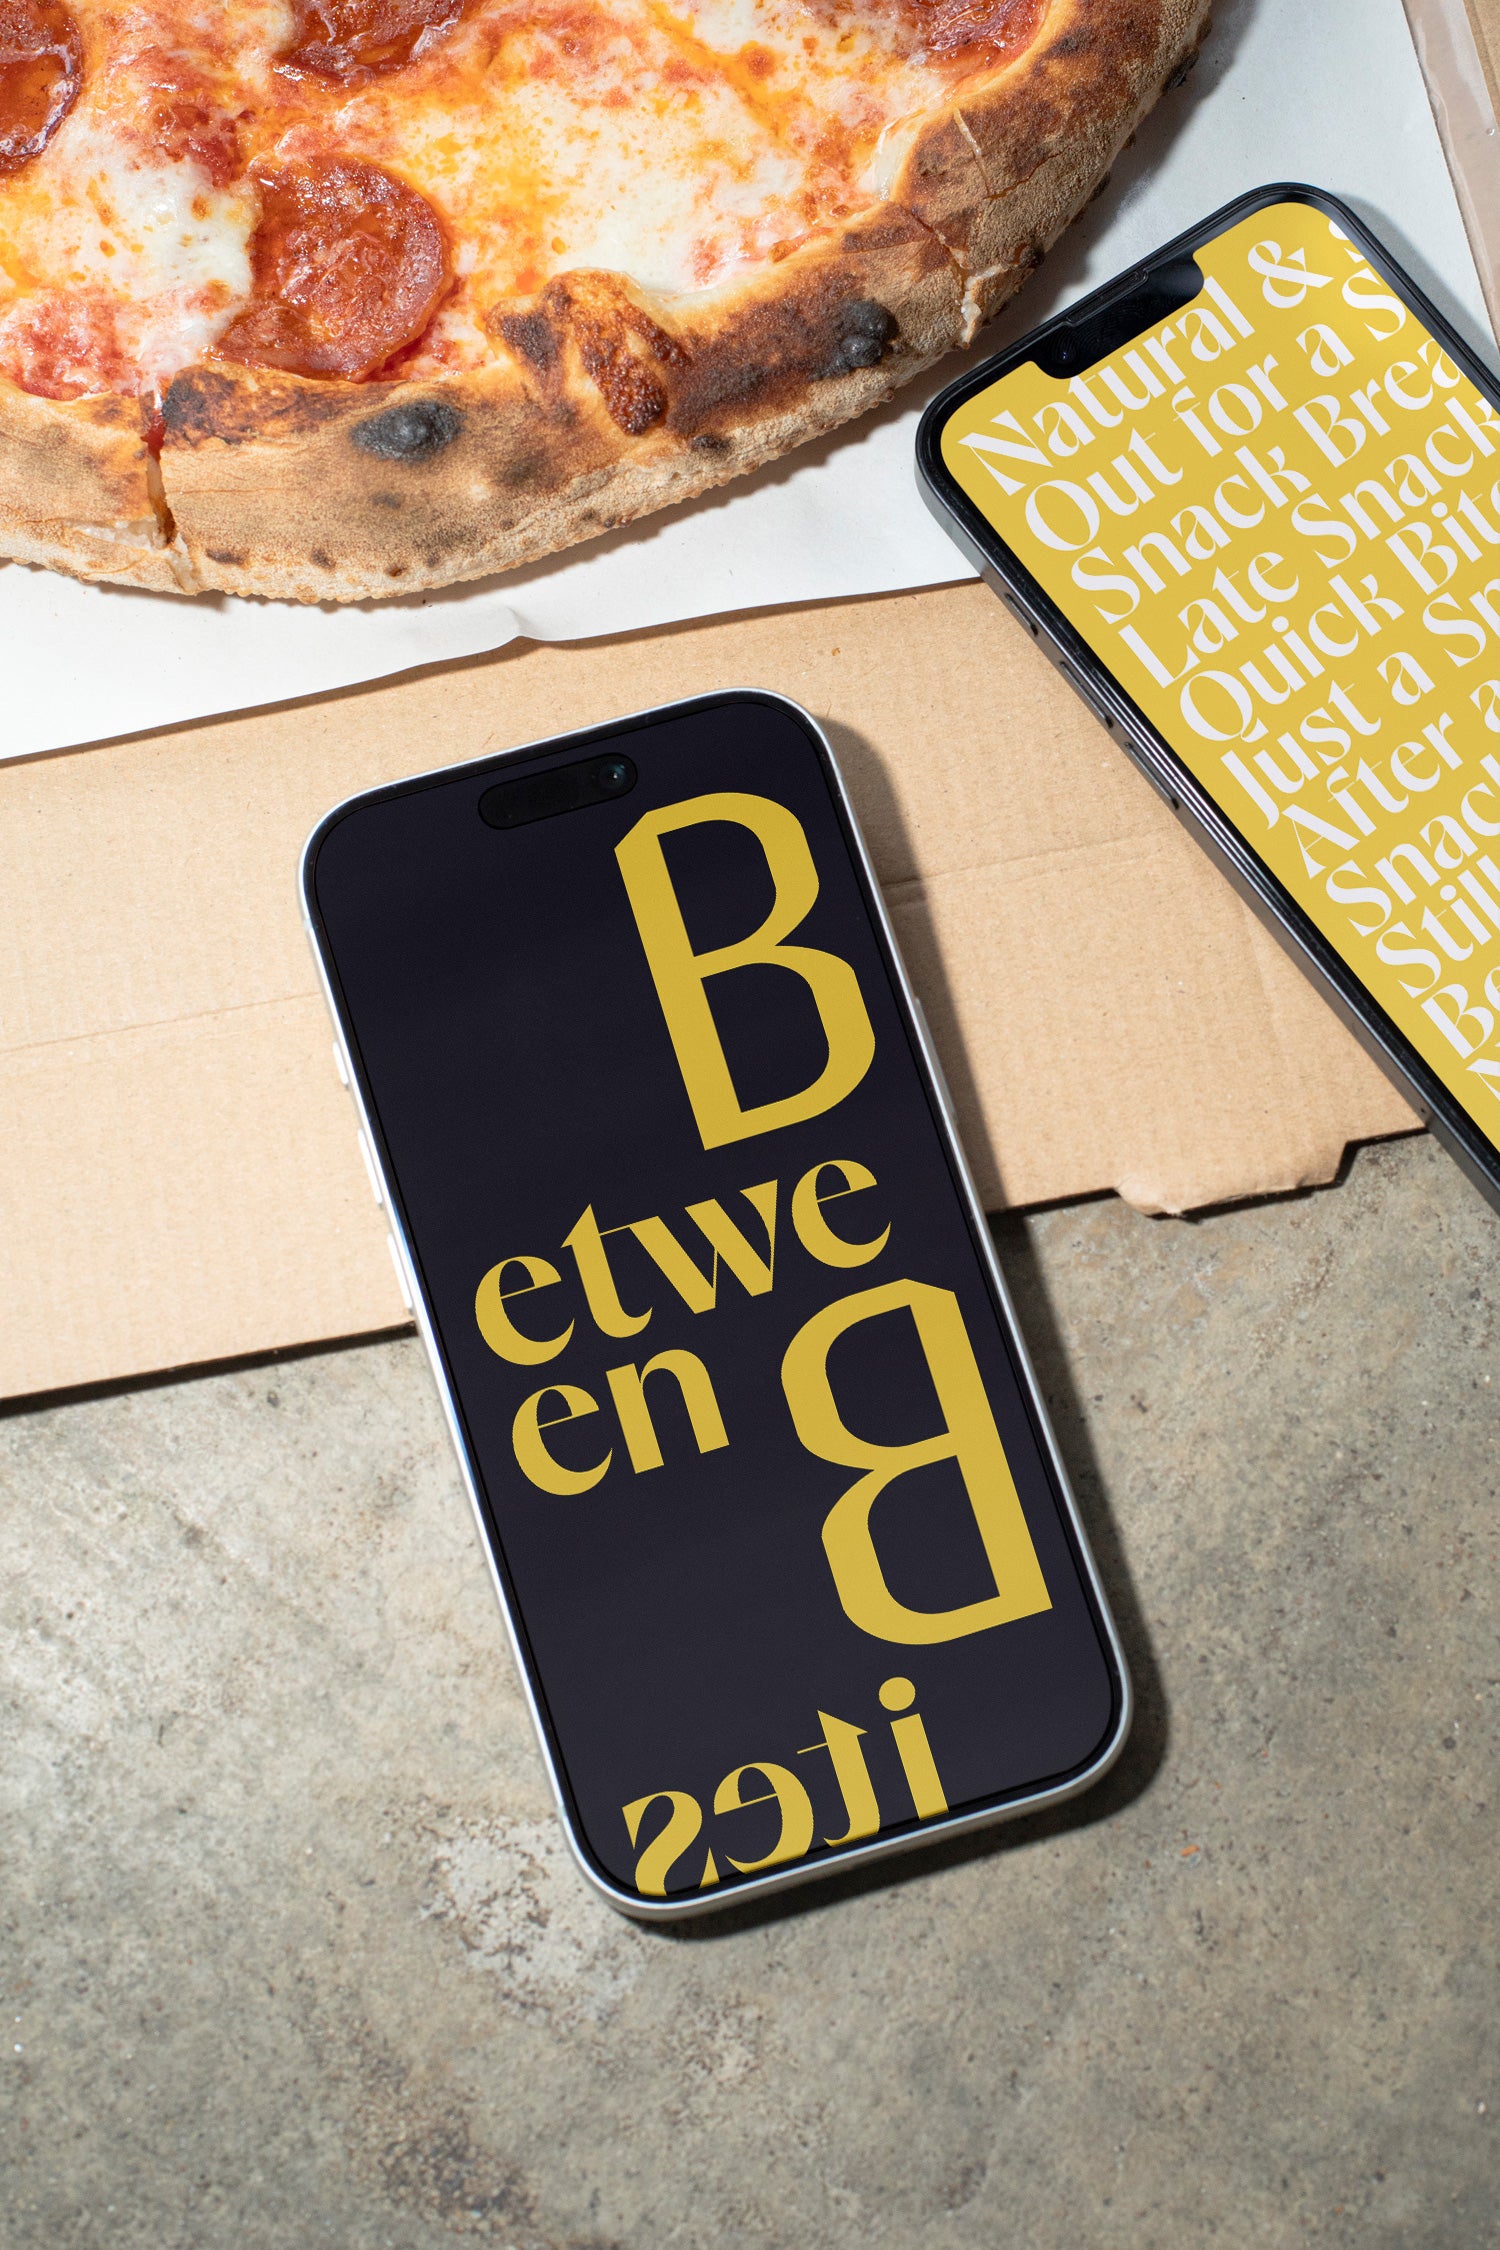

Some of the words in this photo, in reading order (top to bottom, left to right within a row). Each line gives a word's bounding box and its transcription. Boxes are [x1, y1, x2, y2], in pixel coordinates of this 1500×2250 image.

[958, 275, 1256, 497] Natural
[1247, 240, 1335, 310] &
[1024, 427, 1184, 551] Out
[1171, 354, 1290, 458] for
[1295, 323, 1356, 377] a
[1070, 445, 1313, 625] Snack
[1118, 550, 1300, 688] Late
[1290, 397, 1500, 569] Snack
[1179, 574, 1406, 741] Quick
[1385, 480, 1500, 596] Bit
[1220, 680, 1383, 830] Just
[1376, 651, 1437, 706] a
[1281, 711, 1464, 880] After
[1325, 753, 1500, 938] Snac
[613, 792, 876, 1151] B
[474, 1159, 892, 1367] etwe
[511, 1349, 731, 1497] en
